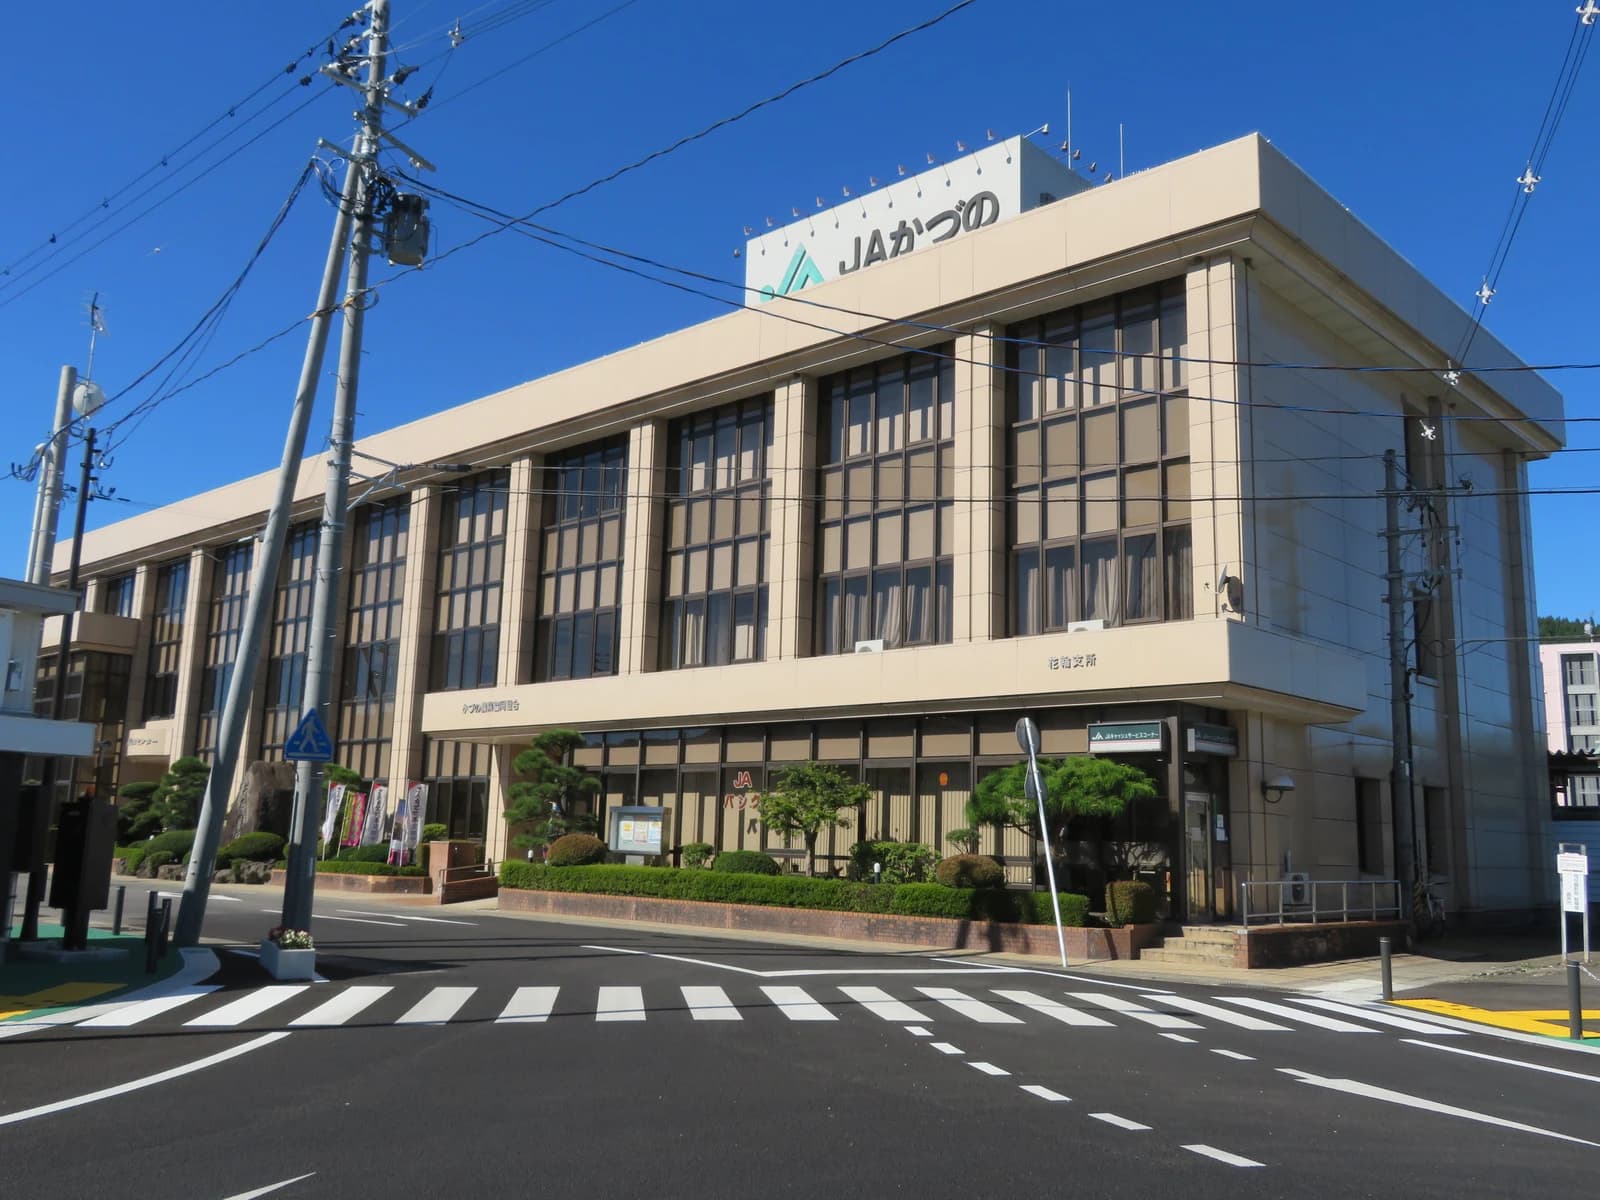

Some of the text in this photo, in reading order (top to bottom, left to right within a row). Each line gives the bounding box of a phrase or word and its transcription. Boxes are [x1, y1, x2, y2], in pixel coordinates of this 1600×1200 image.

[839, 190, 1000, 275] JAかづの
[733, 771, 752, 788] JA
